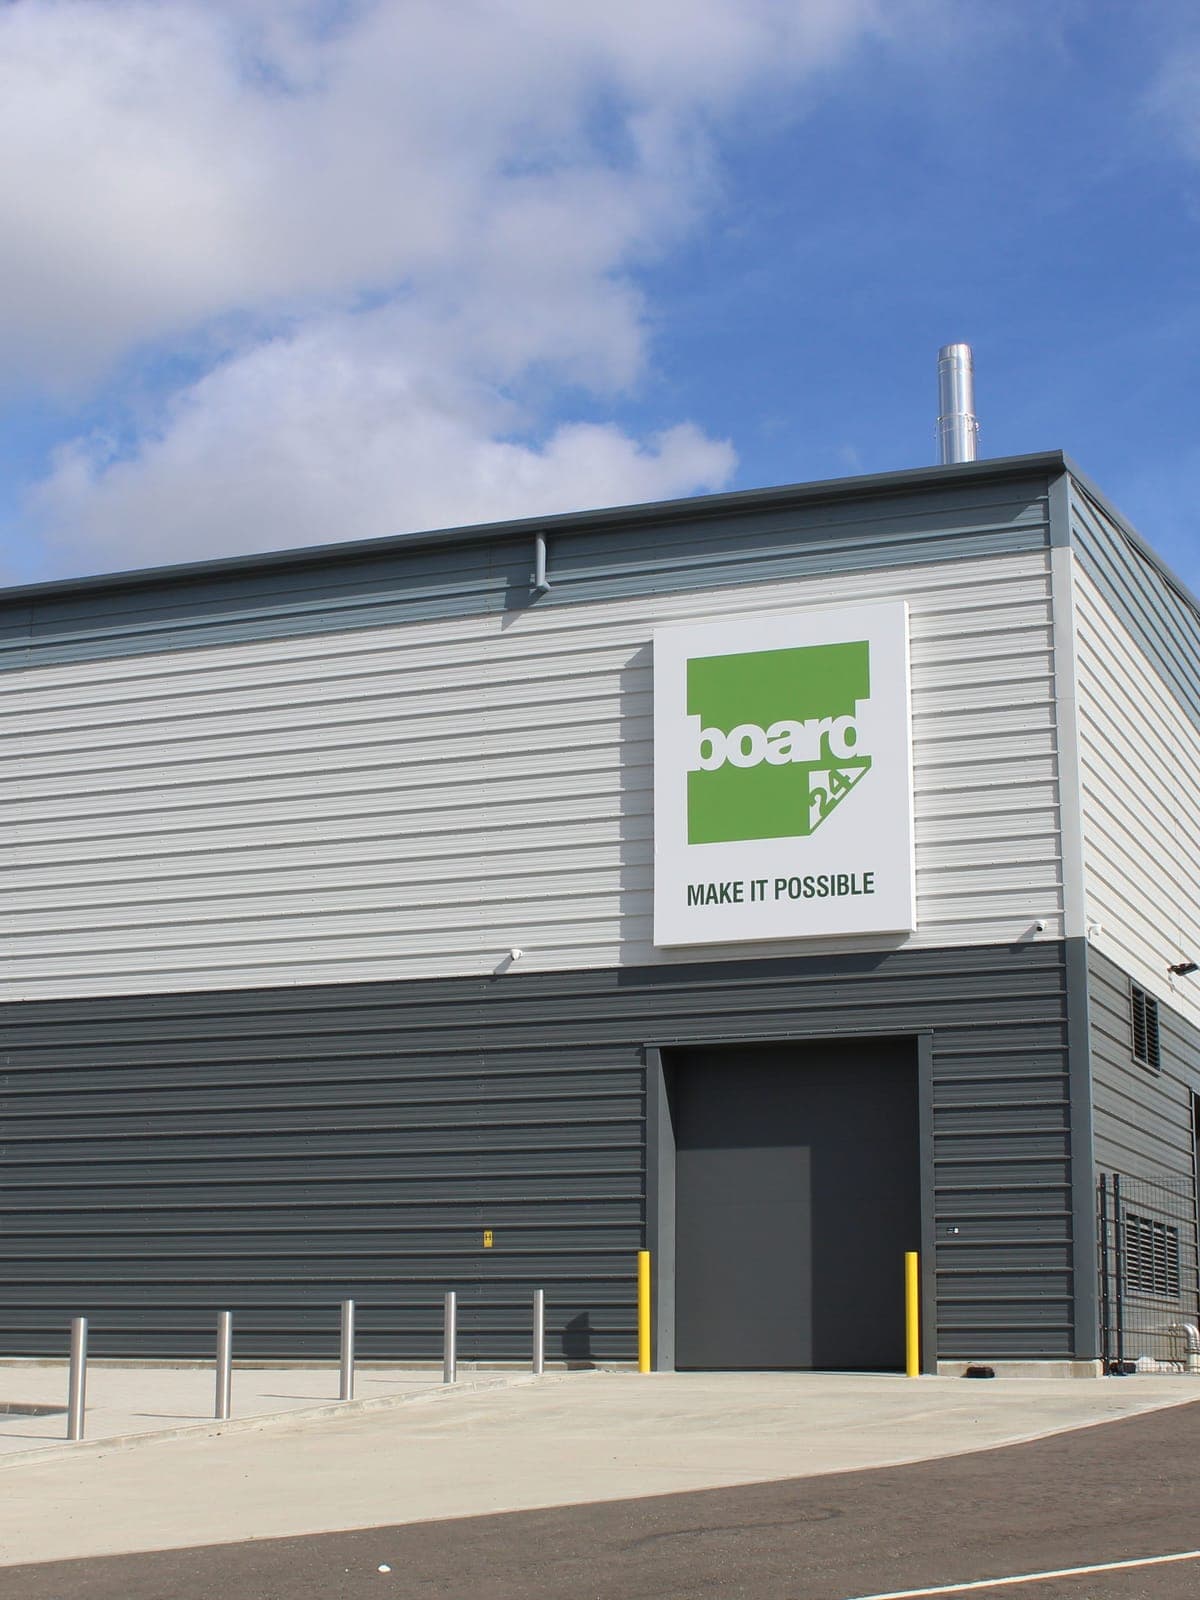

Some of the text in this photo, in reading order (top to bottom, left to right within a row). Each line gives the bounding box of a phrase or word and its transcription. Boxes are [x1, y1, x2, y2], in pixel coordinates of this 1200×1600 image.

[686, 699, 872, 772] board
[809, 769, 852, 817] 24
[687, 872, 875, 906] MAKE IT POSSIBLE
